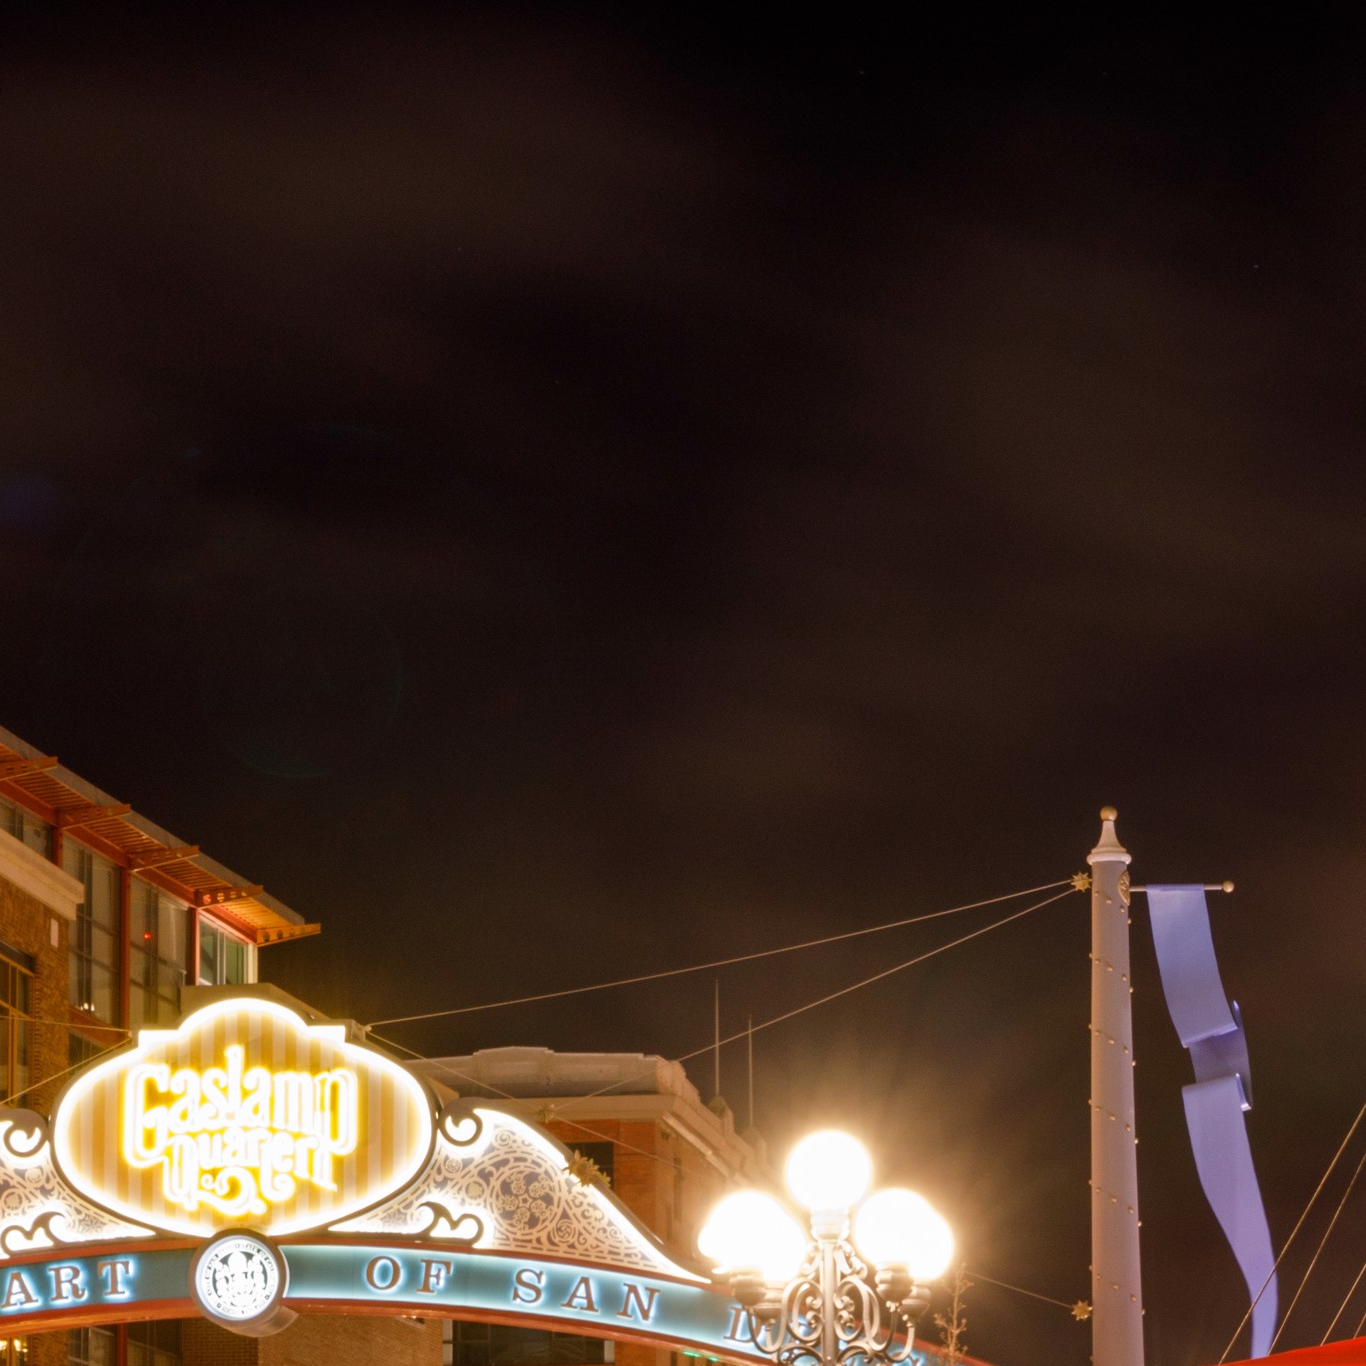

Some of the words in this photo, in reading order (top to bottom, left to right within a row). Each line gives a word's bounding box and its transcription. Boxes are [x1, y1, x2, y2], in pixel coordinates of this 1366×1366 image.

[124, 1044, 358, 1169] Gaslamp
[163, 1126, 337, 1217] Quarter
[365, 1255, 452, 1294] OF
[513, 1268, 660, 1323] SAN
